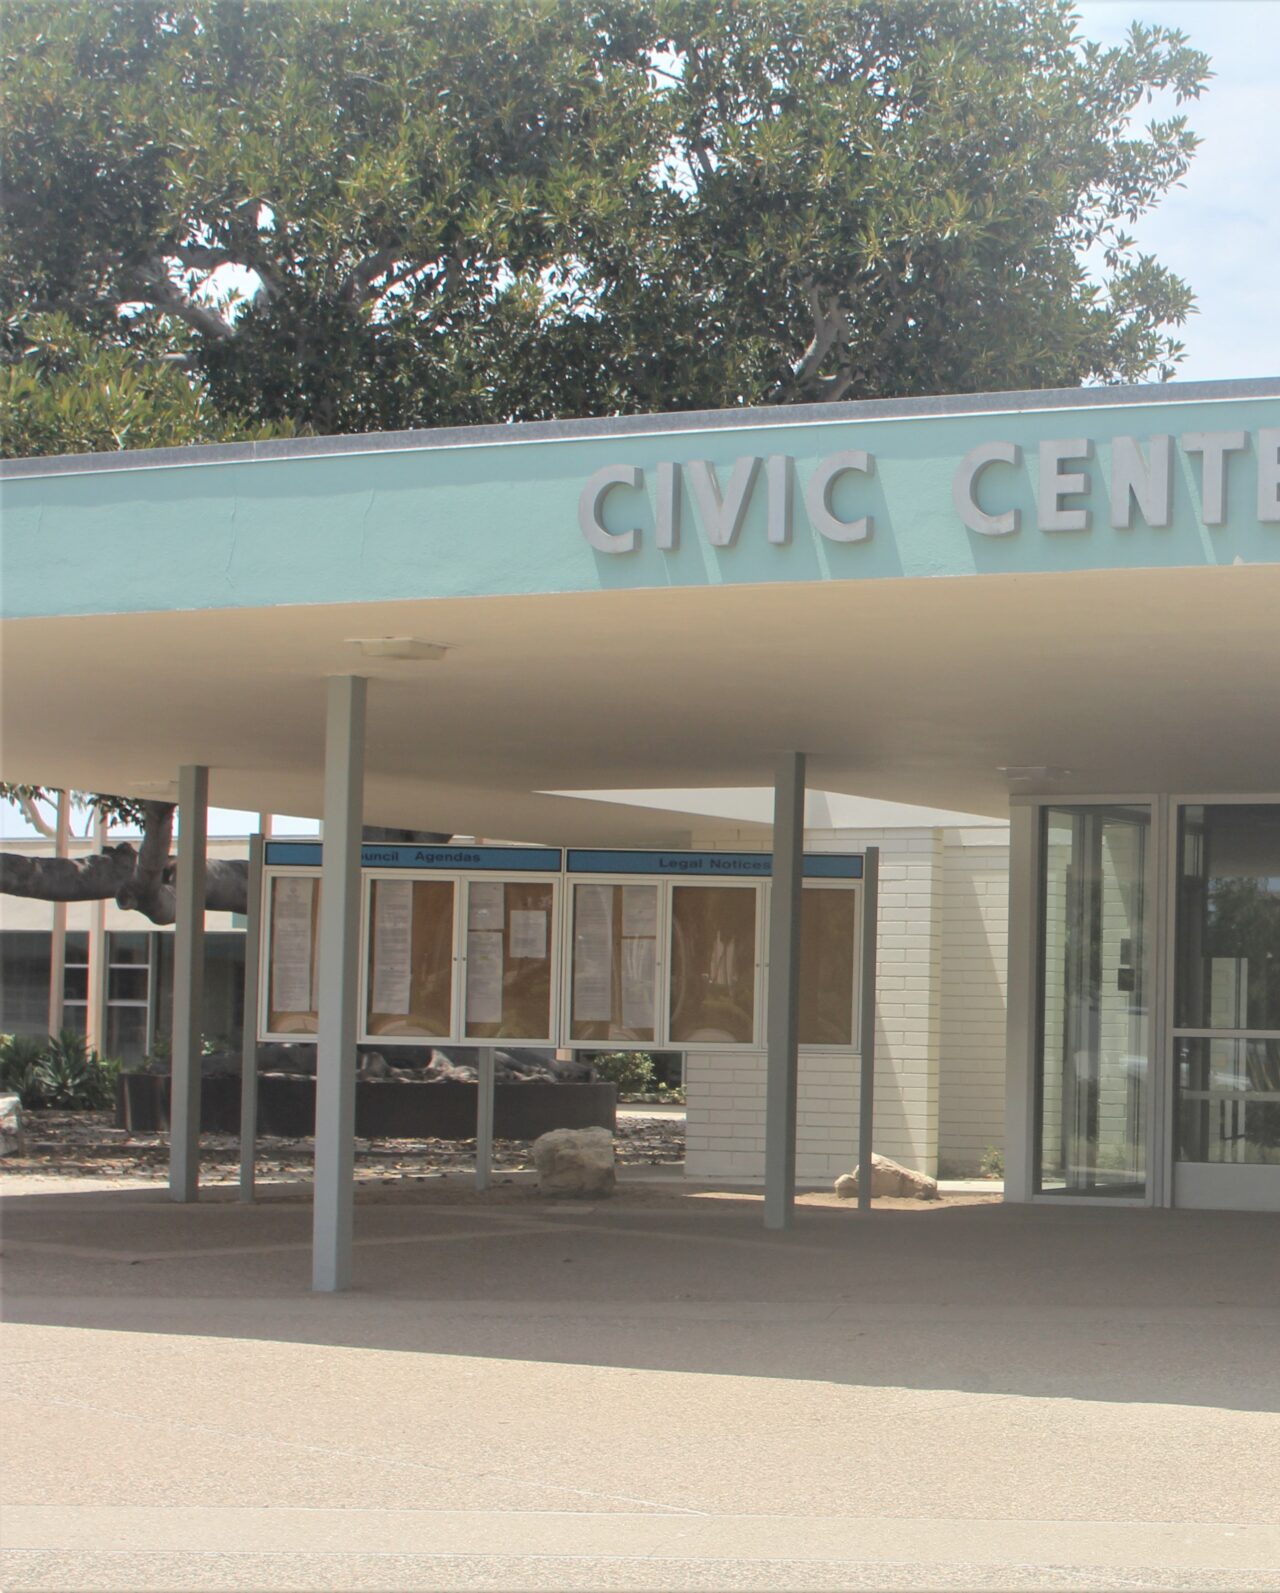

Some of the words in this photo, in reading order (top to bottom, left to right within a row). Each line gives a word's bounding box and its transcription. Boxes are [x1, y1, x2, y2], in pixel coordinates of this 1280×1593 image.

[577, 450, 875, 555] CIVIC
[361, 850, 399, 862] uncil
[414, 850, 481, 864] Agendas
[658, 857, 703, 871] Legal
[710, 858, 773, 871] Notices
